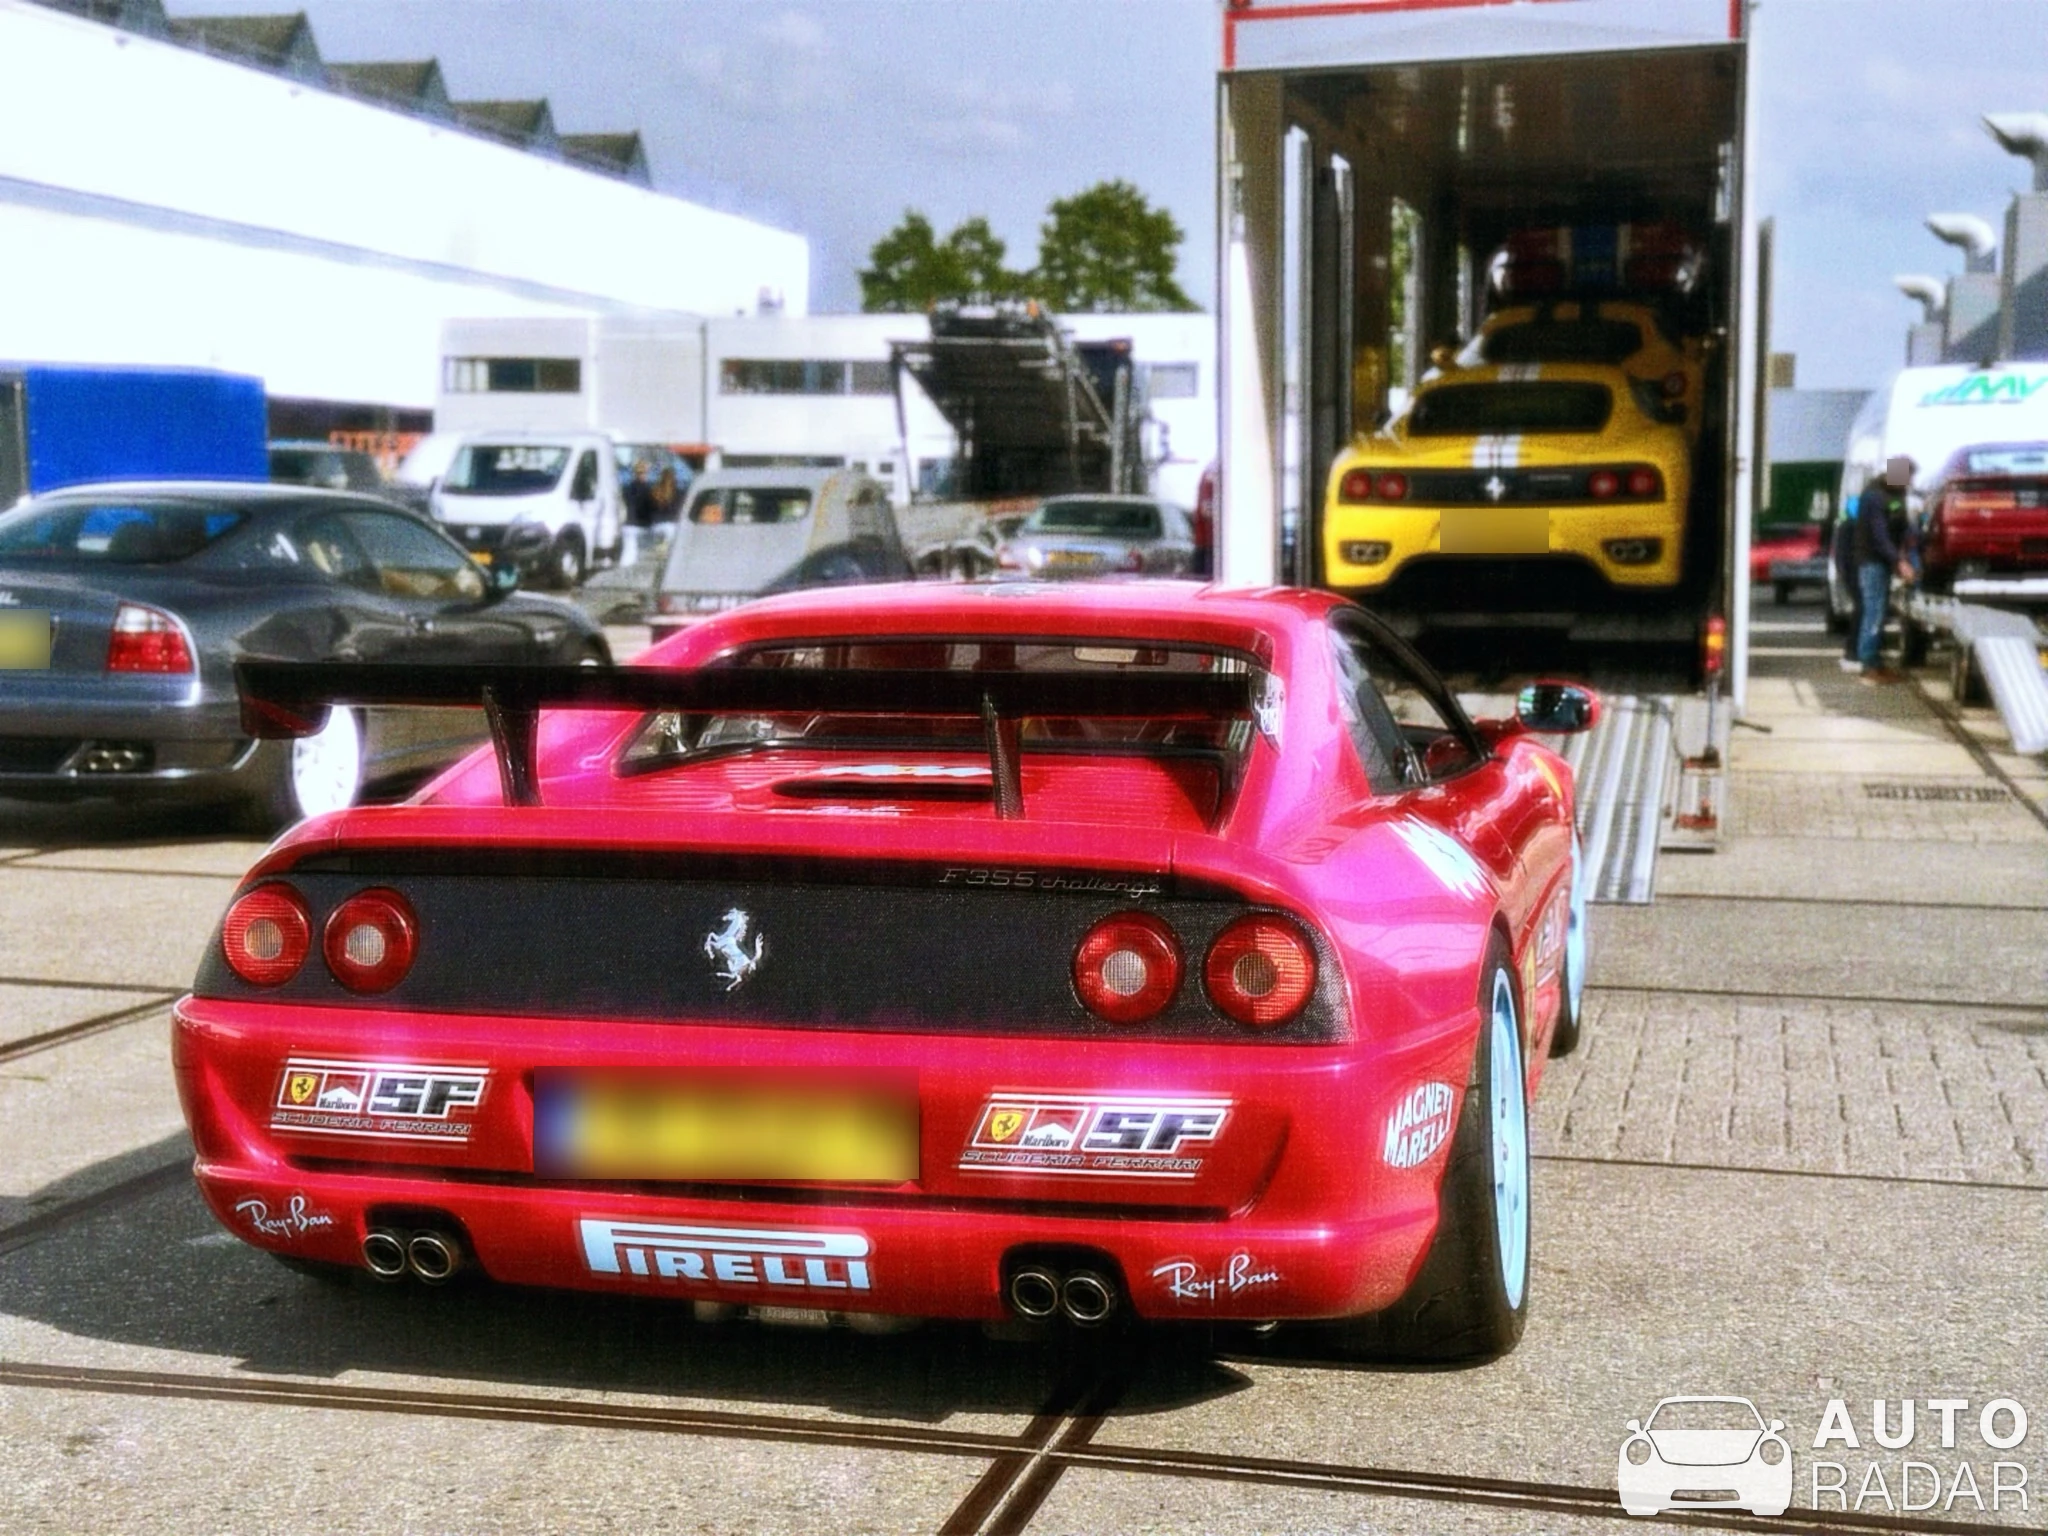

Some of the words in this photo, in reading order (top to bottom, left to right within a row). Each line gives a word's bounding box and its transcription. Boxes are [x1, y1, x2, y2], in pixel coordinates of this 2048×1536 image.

[938, 868, 1037, 887] F355
[1039, 876, 1161, 898] challenge
[319, 1097, 358, 1111] Marlboro
[367, 1071, 486, 1119] SF
[271, 1111, 373, 1129] SCUDERIA
[380, 1119, 472, 1135] FERRARI
[1022, 1133, 1070, 1148] Marlboro
[1081, 1105, 1227, 1154] SF
[961, 1151, 1084, 1165] SCUDERIA
[1093, 1158, 1203, 1170] FERRARI
[236, 1196, 333, 1238] Ray-Ban
[580, 1219, 870, 1289] PIRELLI
[1153, 1254, 1279, 1300] Ray-Ban
